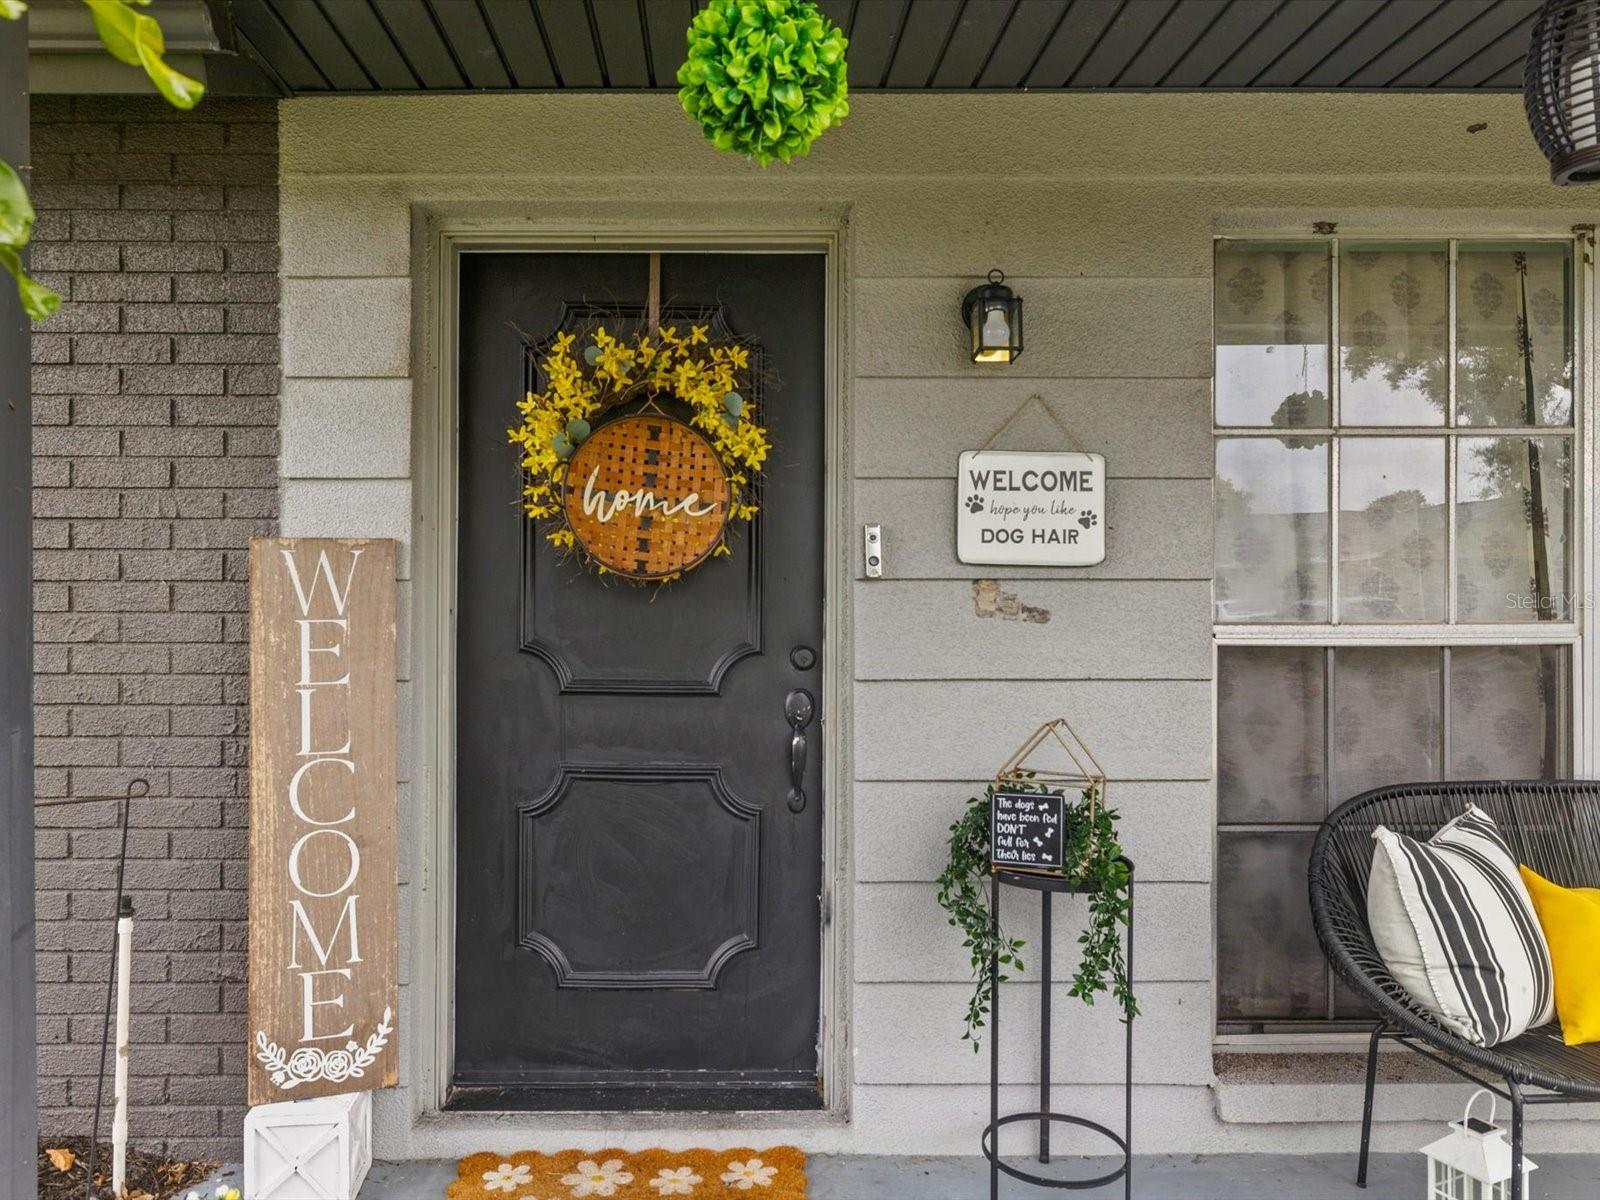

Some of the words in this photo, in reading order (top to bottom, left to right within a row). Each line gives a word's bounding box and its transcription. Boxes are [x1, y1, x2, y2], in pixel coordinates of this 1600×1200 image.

[969, 470, 1093, 492] WELCOME
[583, 464, 718, 522] home
[990, 500, 1020, 521] hope
[1023, 506, 1046, 521] you
[1050, 500, 1077, 515] like
[981, 529, 1024, 544] DOG
[1032, 529, 1079, 545] HAIR
[280, 549, 365, 1043] WELCOME
[997, 797, 1012, 809] The
[1014, 799, 1035, 812] dogs
[997, 810, 1017, 821] have
[1019, 812, 1040, 822] been
[1043, 813, 1058, 824] fed
[997, 823, 1027, 835] DON'T
[997, 836, 1013, 847] fall
[1015, 837, 1030, 849] for
[1021, 850, 1037, 861] lies
